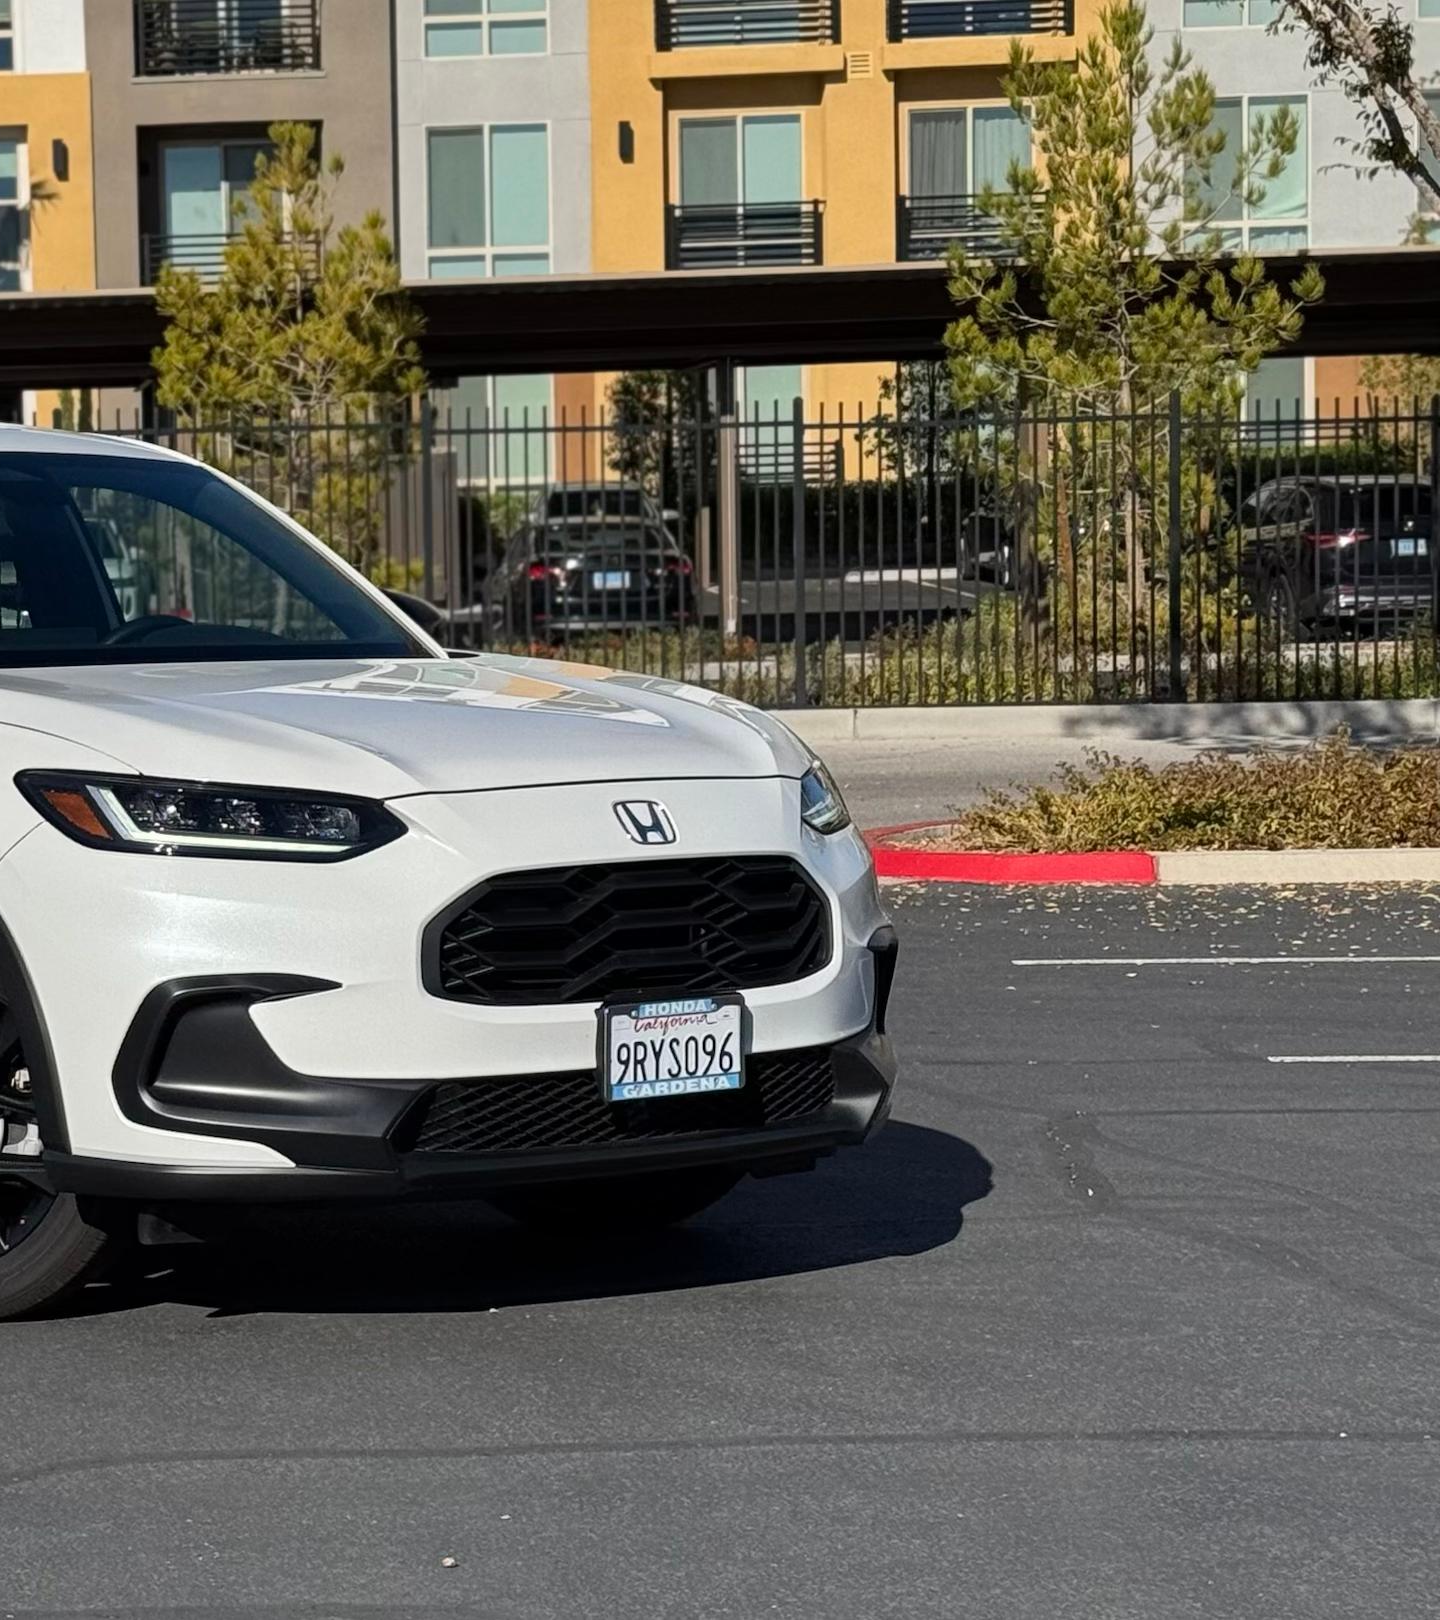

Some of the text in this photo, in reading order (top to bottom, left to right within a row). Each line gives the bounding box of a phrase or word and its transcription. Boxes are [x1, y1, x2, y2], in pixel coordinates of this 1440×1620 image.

[643, 1000, 708, 1017] HONDA
[633, 1015, 717, 1036] California
[616, 1031, 733, 1084] 9RYS096
[622, 1076, 731, 1098] GARDENA
